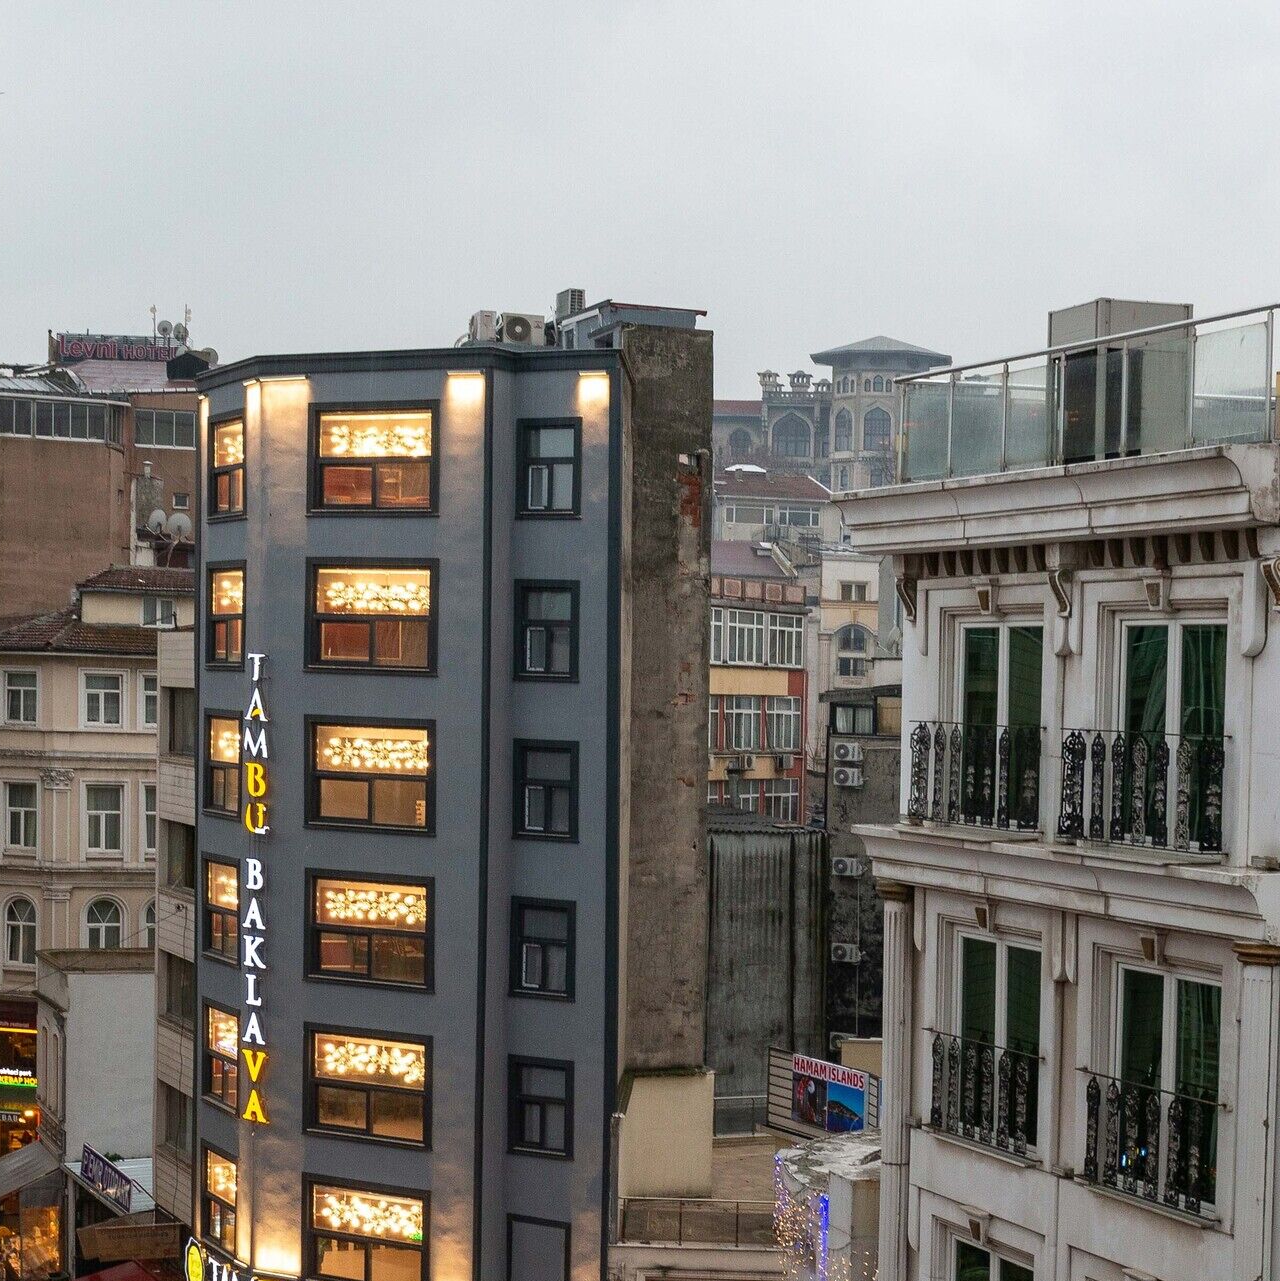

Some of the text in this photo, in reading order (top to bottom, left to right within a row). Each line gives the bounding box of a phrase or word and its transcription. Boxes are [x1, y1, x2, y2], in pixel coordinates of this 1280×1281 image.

[123, 344, 177, 361] HOTEL
[241, 857, 270, 1125] BAKLAVA
[0, 1075, 23, 1084] KEBAP
[793, 1056, 865, 1089] HAMAM ISLANDS
